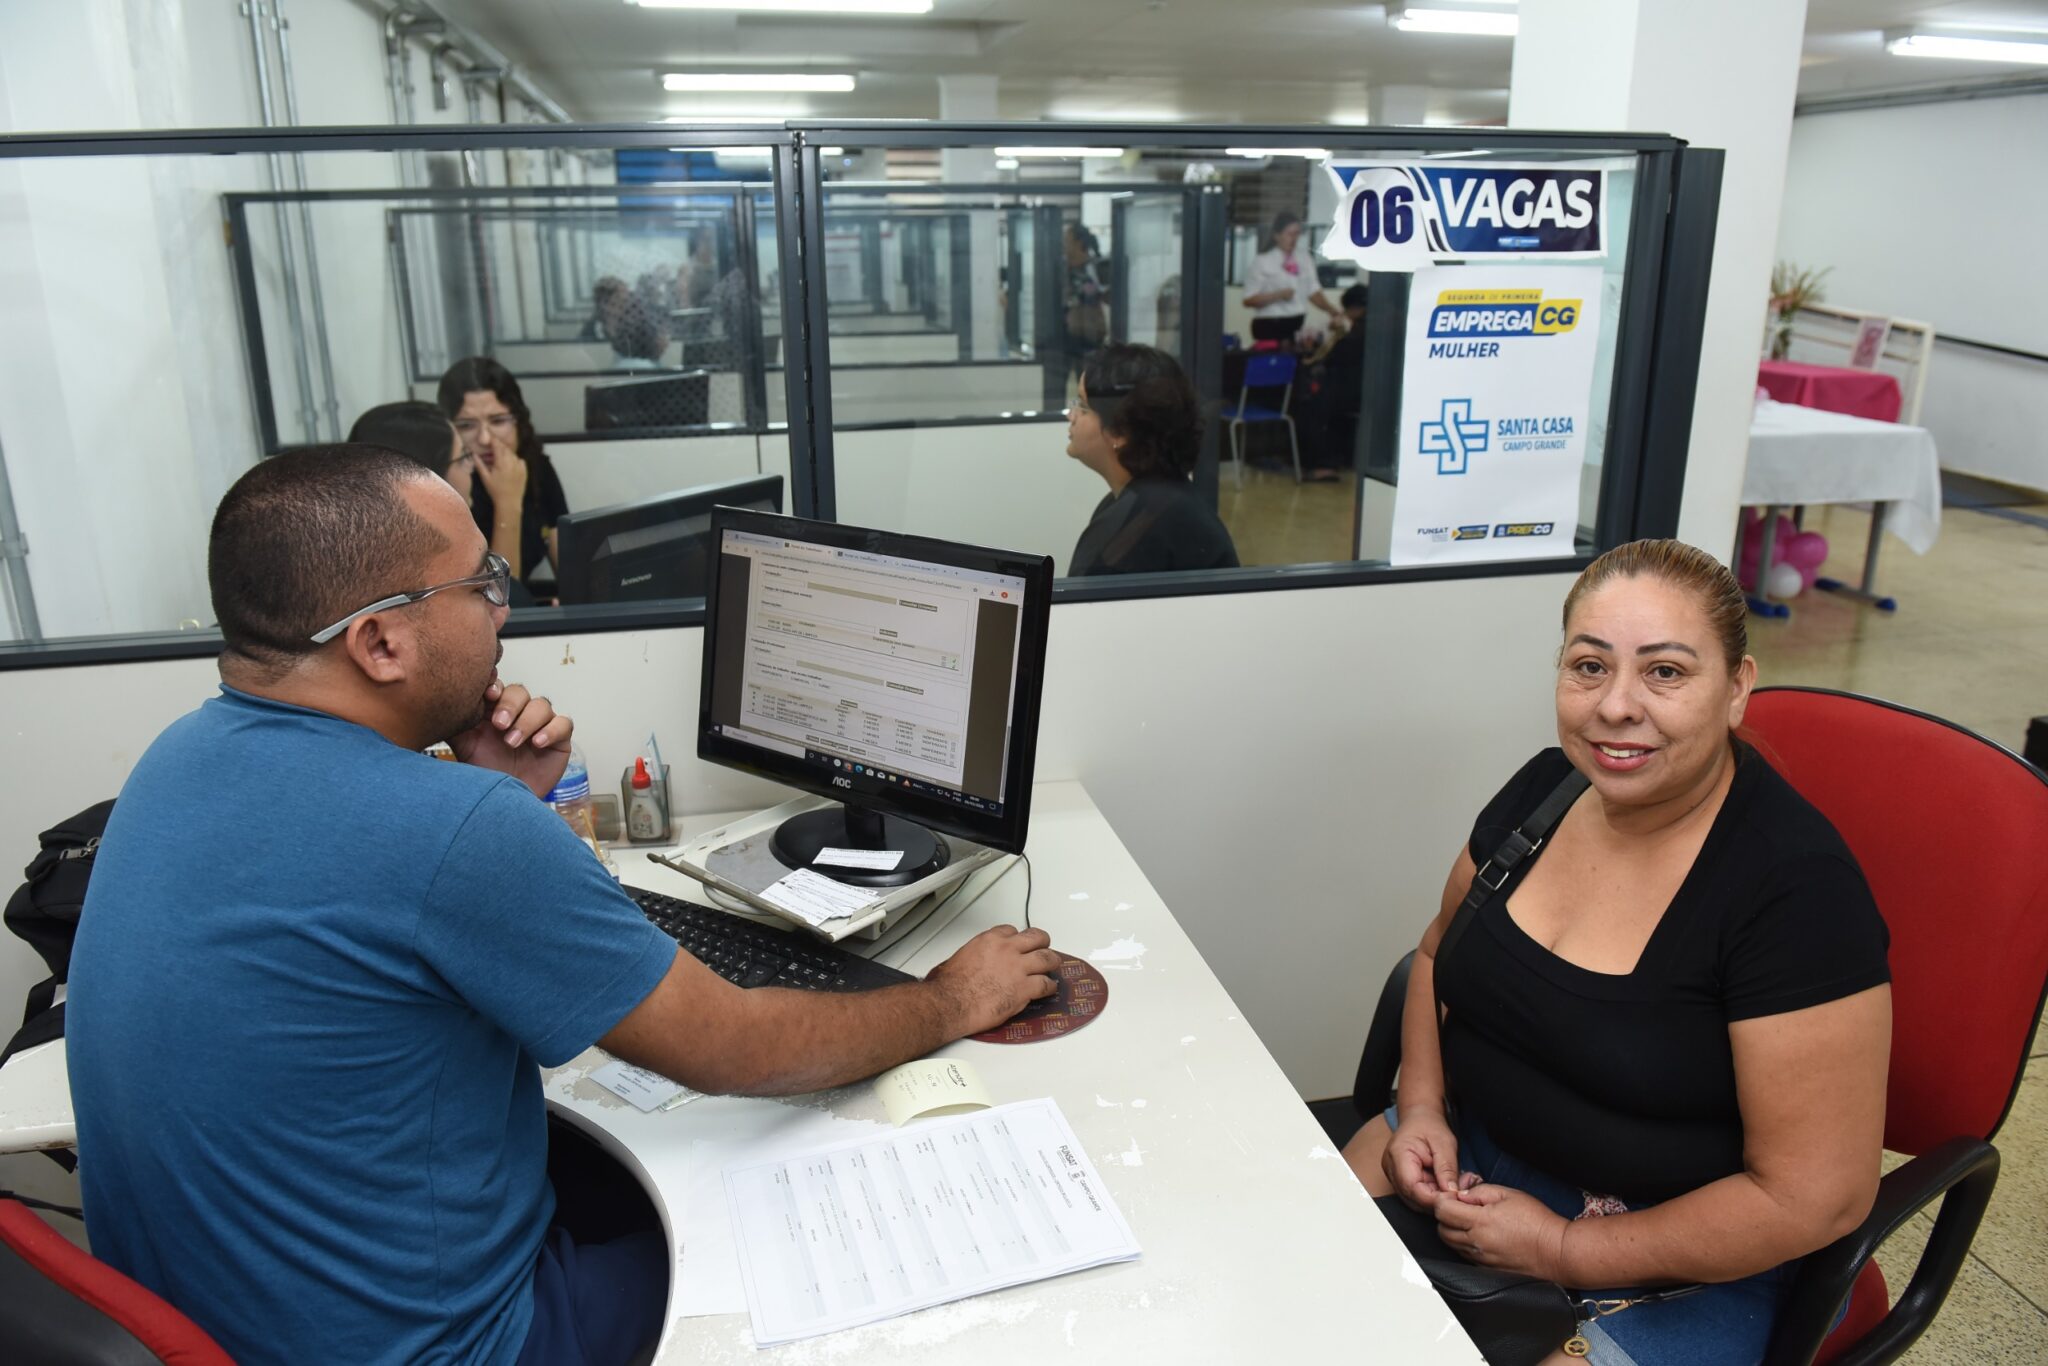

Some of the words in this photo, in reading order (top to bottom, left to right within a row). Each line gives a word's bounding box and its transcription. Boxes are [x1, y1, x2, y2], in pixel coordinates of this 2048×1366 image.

[1438, 176, 1594, 229] VAGAS
[1350, 185, 1414, 248] 06
[1434, 309, 1533, 333] EMPREGA
[1540, 306, 1575, 326] CG
[1428, 342, 1500, 359] MULHER
[1497, 418, 1539, 436] SANTA
[1542, 416, 1574, 435] CASA
[1503, 440, 1533, 452] CAMPO
[1534, 439, 1567, 451] GRANDE
[1417, 526, 1449, 536] FUNSAT
[832, 775, 852, 790] AOC
[1058, 1144, 1078, 1167] FUNSAT
